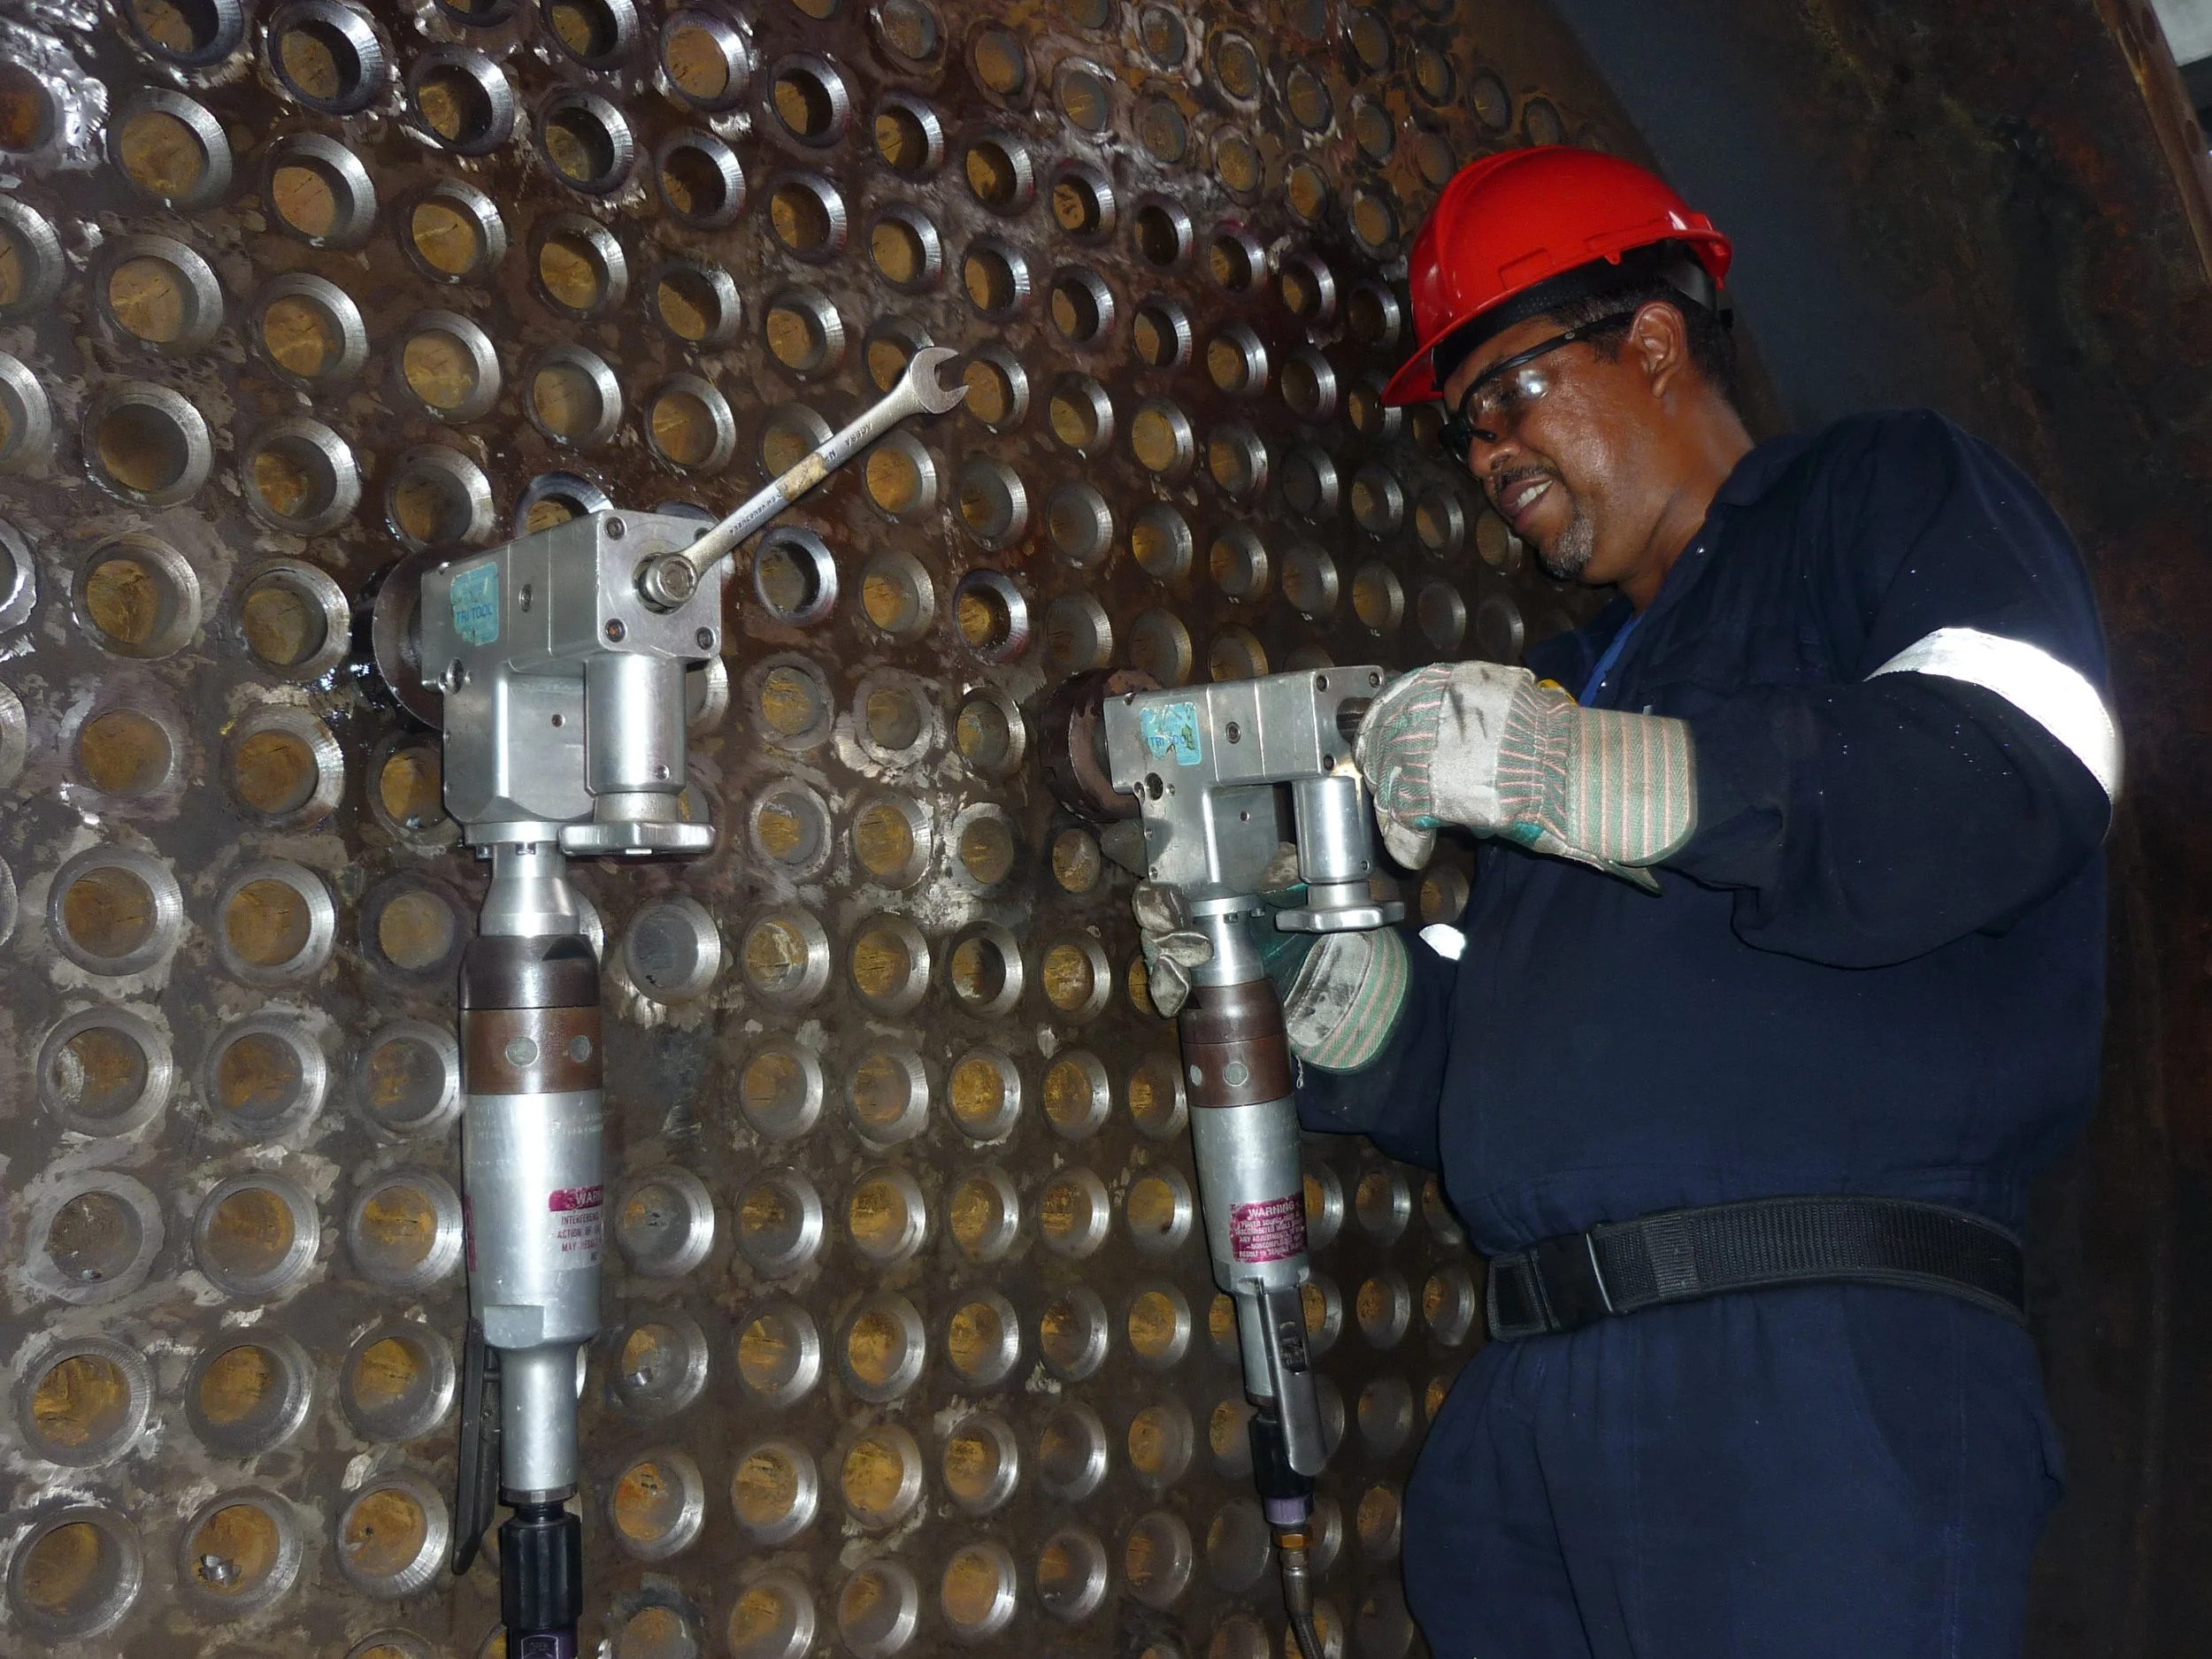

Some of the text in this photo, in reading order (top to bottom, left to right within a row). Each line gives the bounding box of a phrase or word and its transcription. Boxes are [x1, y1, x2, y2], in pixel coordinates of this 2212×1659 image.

[729, 503, 767, 534] VENEZUELA
[456, 610, 469, 624] TRI
[1149, 736, 1164, 747] TRI
[1248, 1201, 1294, 1217] WARNING
[557, 1227, 581, 1239] ACTION
[562, 1241, 577, 1252] MAY
